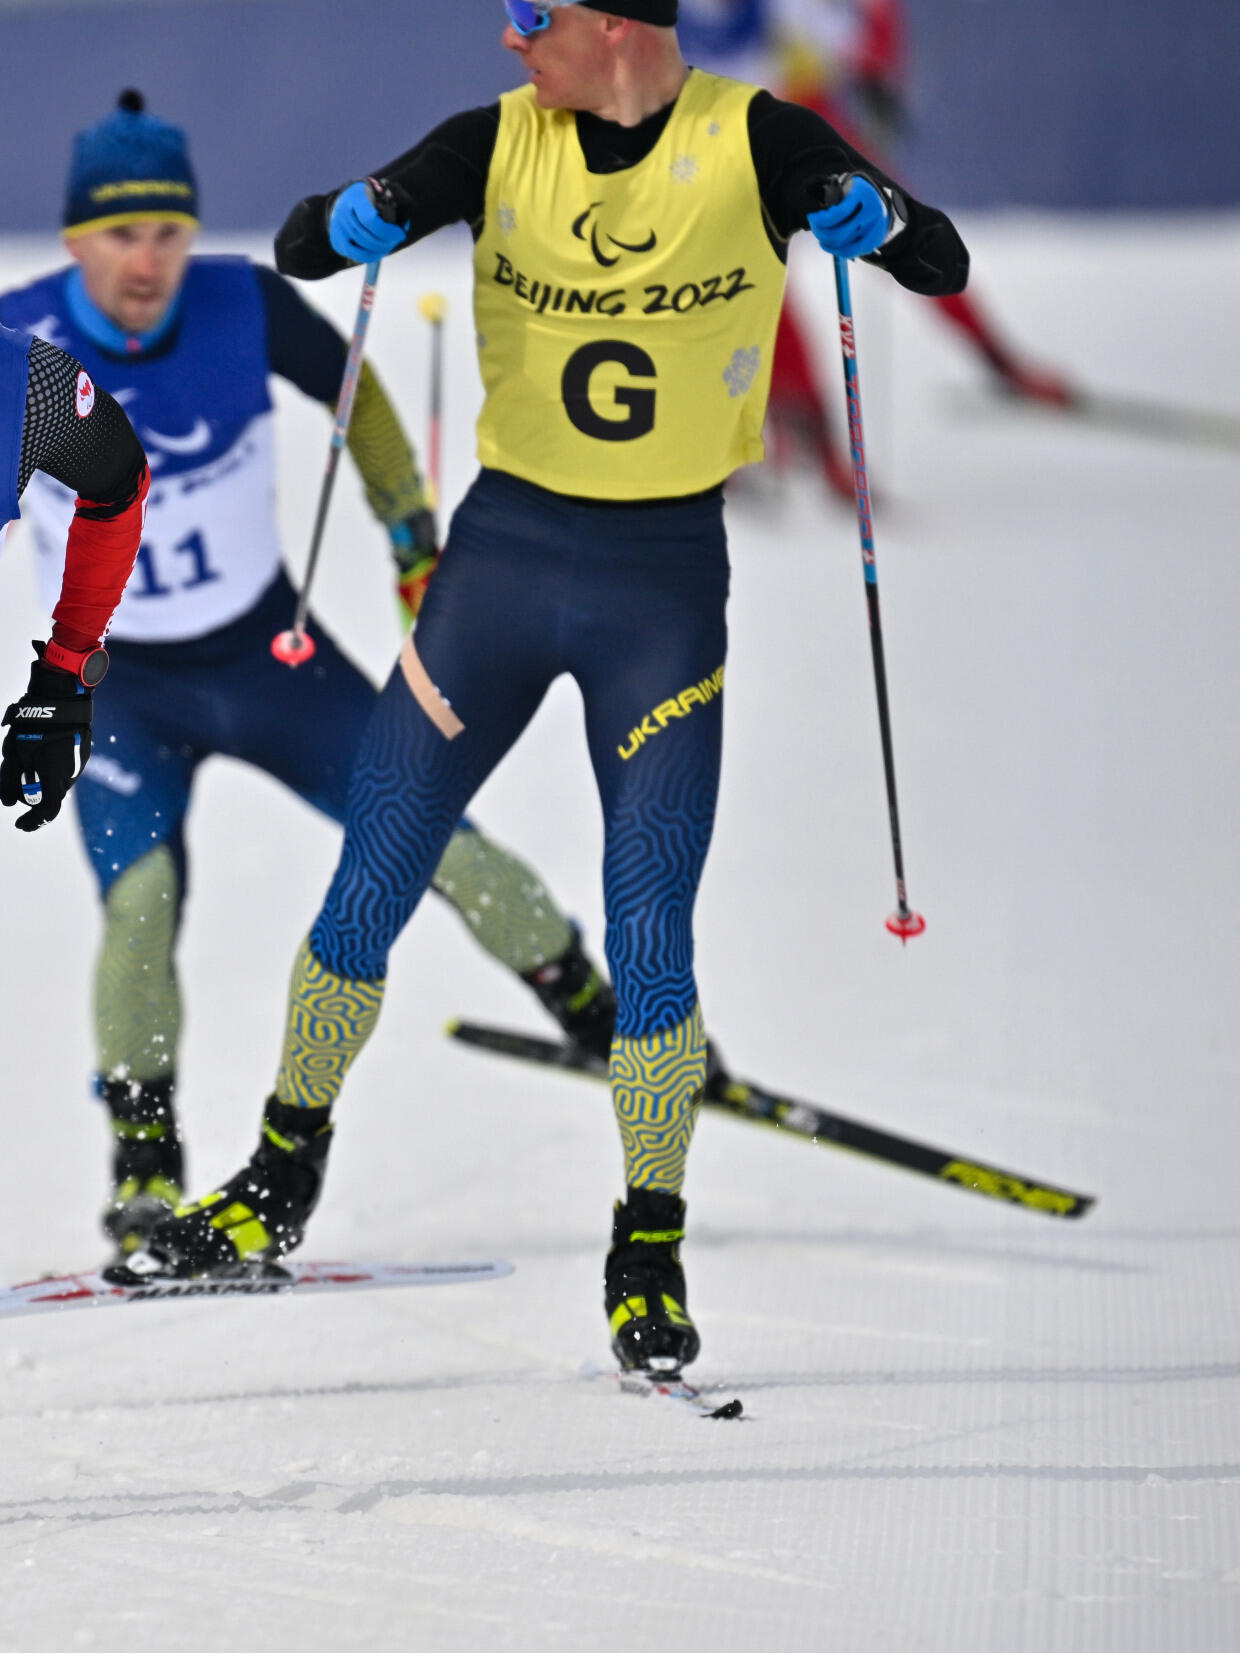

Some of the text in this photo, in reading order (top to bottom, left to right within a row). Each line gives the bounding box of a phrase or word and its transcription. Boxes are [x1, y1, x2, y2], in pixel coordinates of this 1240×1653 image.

[493, 253, 755, 316] BEIJING 2022
[561, 340, 658, 442] G
[131, 527, 223, 599] 11
